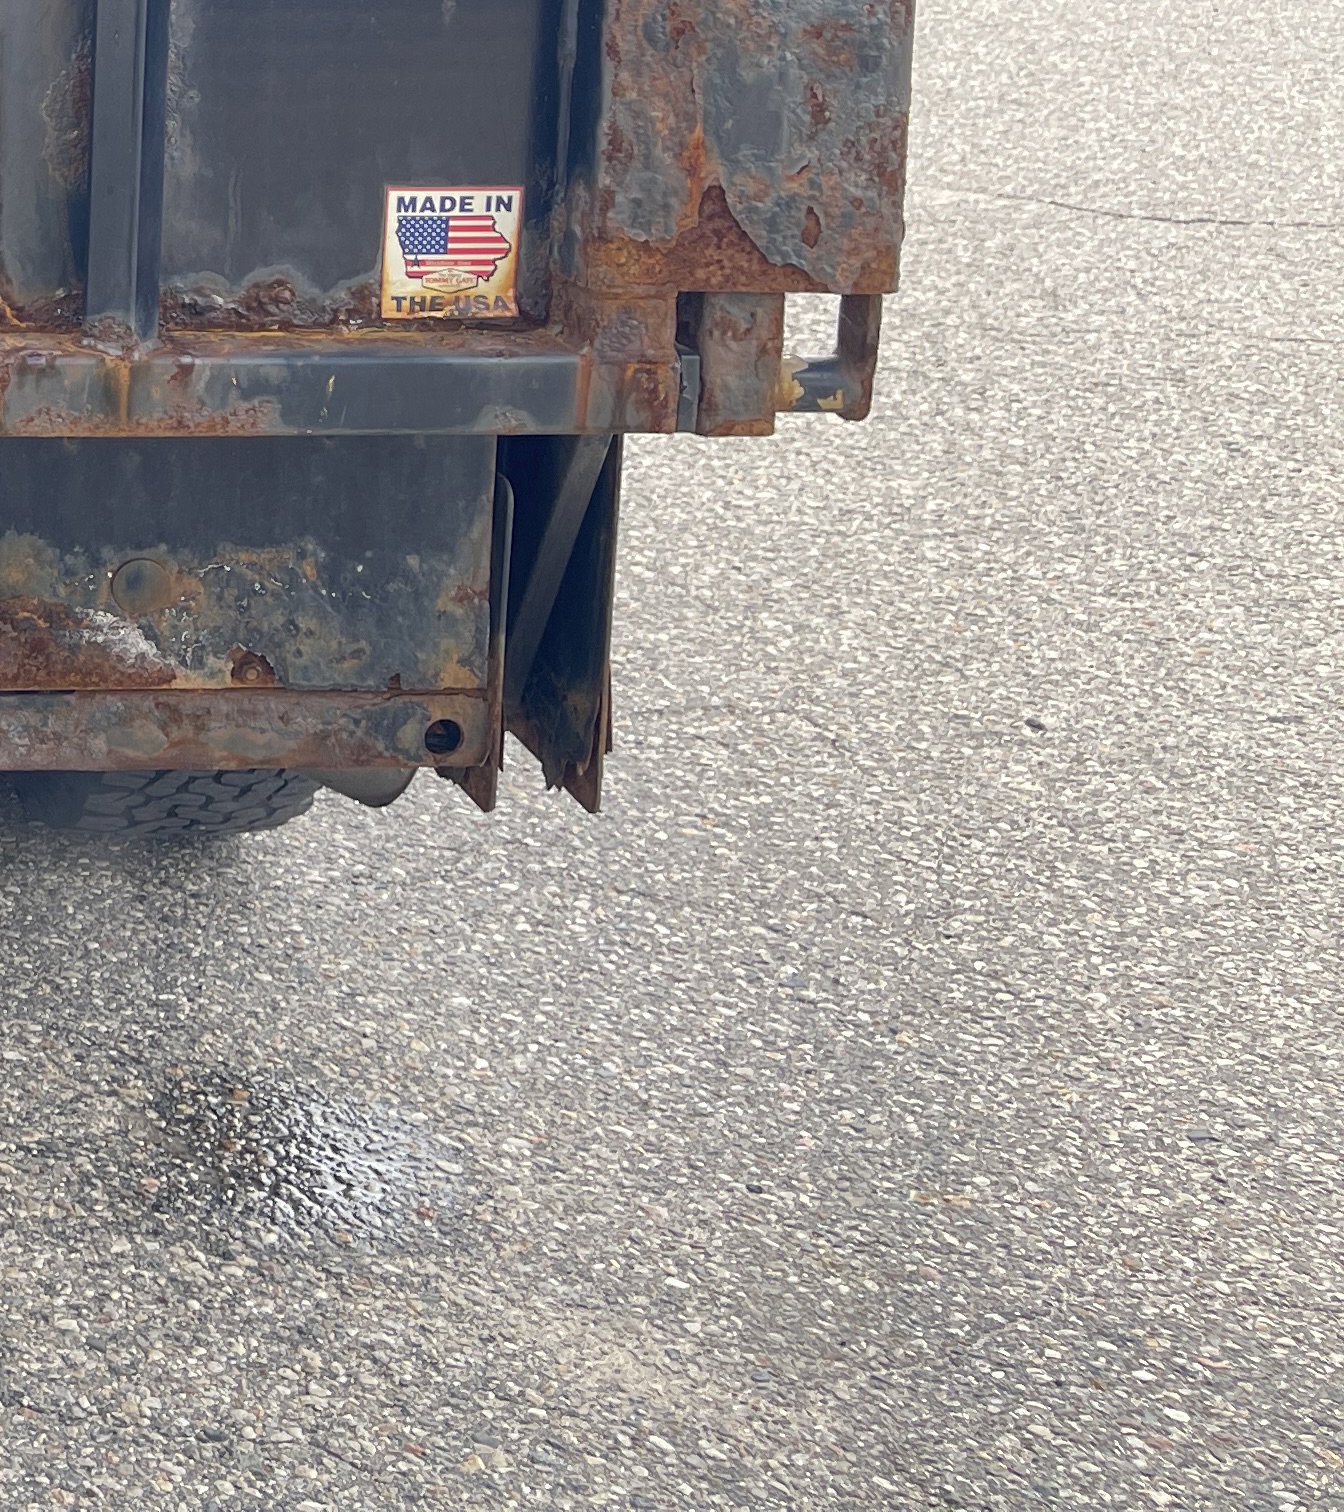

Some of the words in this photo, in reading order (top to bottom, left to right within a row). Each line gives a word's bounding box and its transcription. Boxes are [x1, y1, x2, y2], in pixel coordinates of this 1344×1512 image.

[396, 196, 474, 212] MADE
[485, 196, 513, 212] IN
[391, 296, 444, 312] THE
[452, 295, 513, 312] USA
